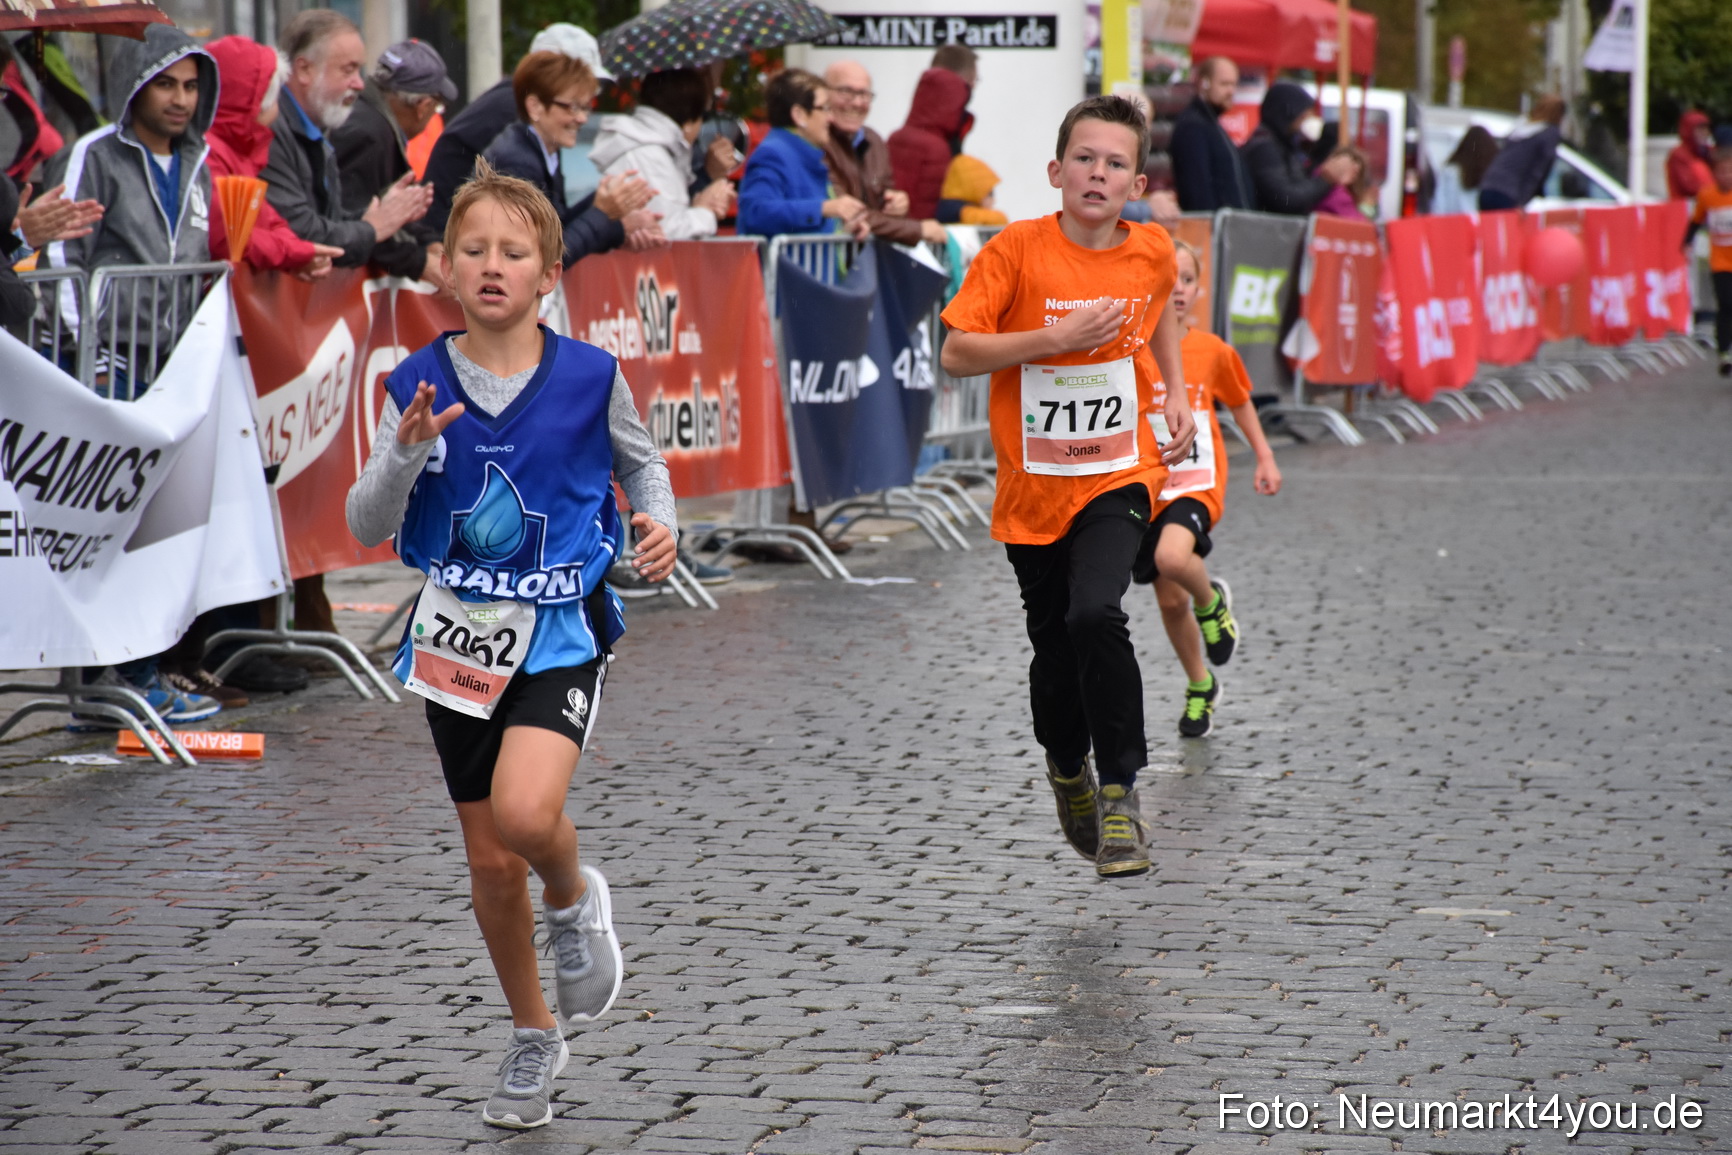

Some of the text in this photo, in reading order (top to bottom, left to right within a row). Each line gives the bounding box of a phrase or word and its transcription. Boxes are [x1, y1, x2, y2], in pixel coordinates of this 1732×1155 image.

[1066, 374, 1107, 386] BOCK
[1039, 396, 1122, 432] 7172
[1065, 445, 1101, 457] Jonas
[432, 612, 517, 668] 7052
[450, 670, 490, 695] Julian
